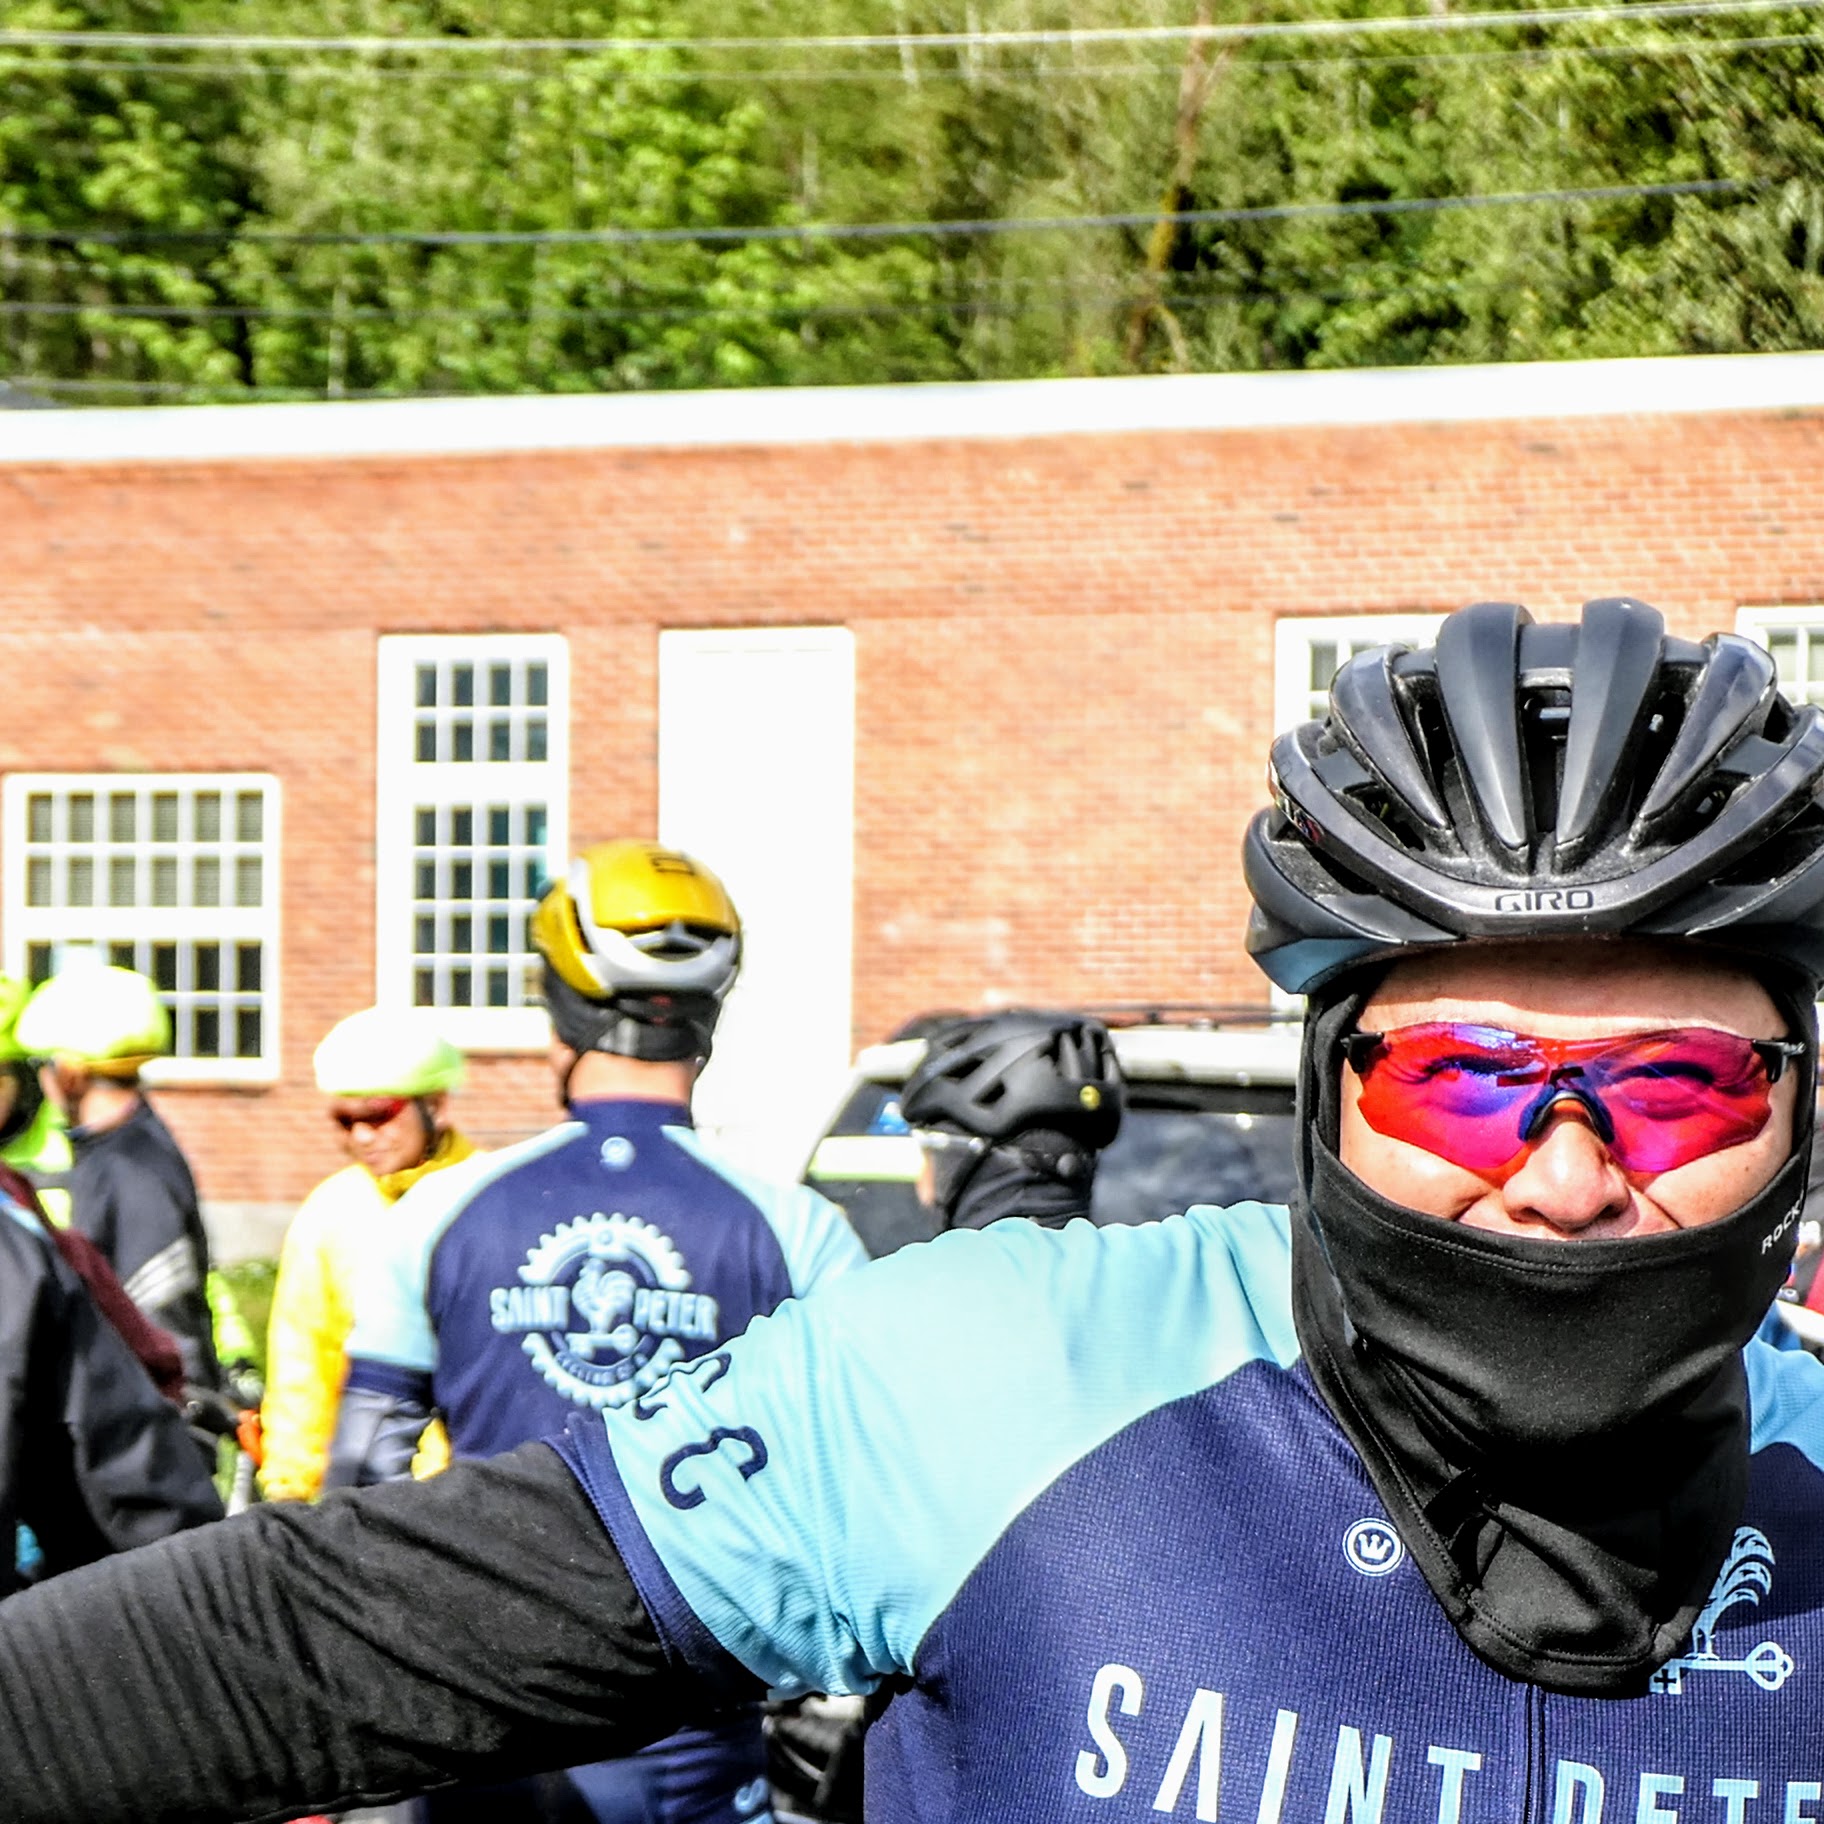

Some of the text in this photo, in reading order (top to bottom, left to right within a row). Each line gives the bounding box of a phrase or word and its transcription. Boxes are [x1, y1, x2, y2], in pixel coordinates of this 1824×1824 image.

[1494, 888, 1595, 912] GIRO
[489, 1286, 720, 1342] SAINT PETER
